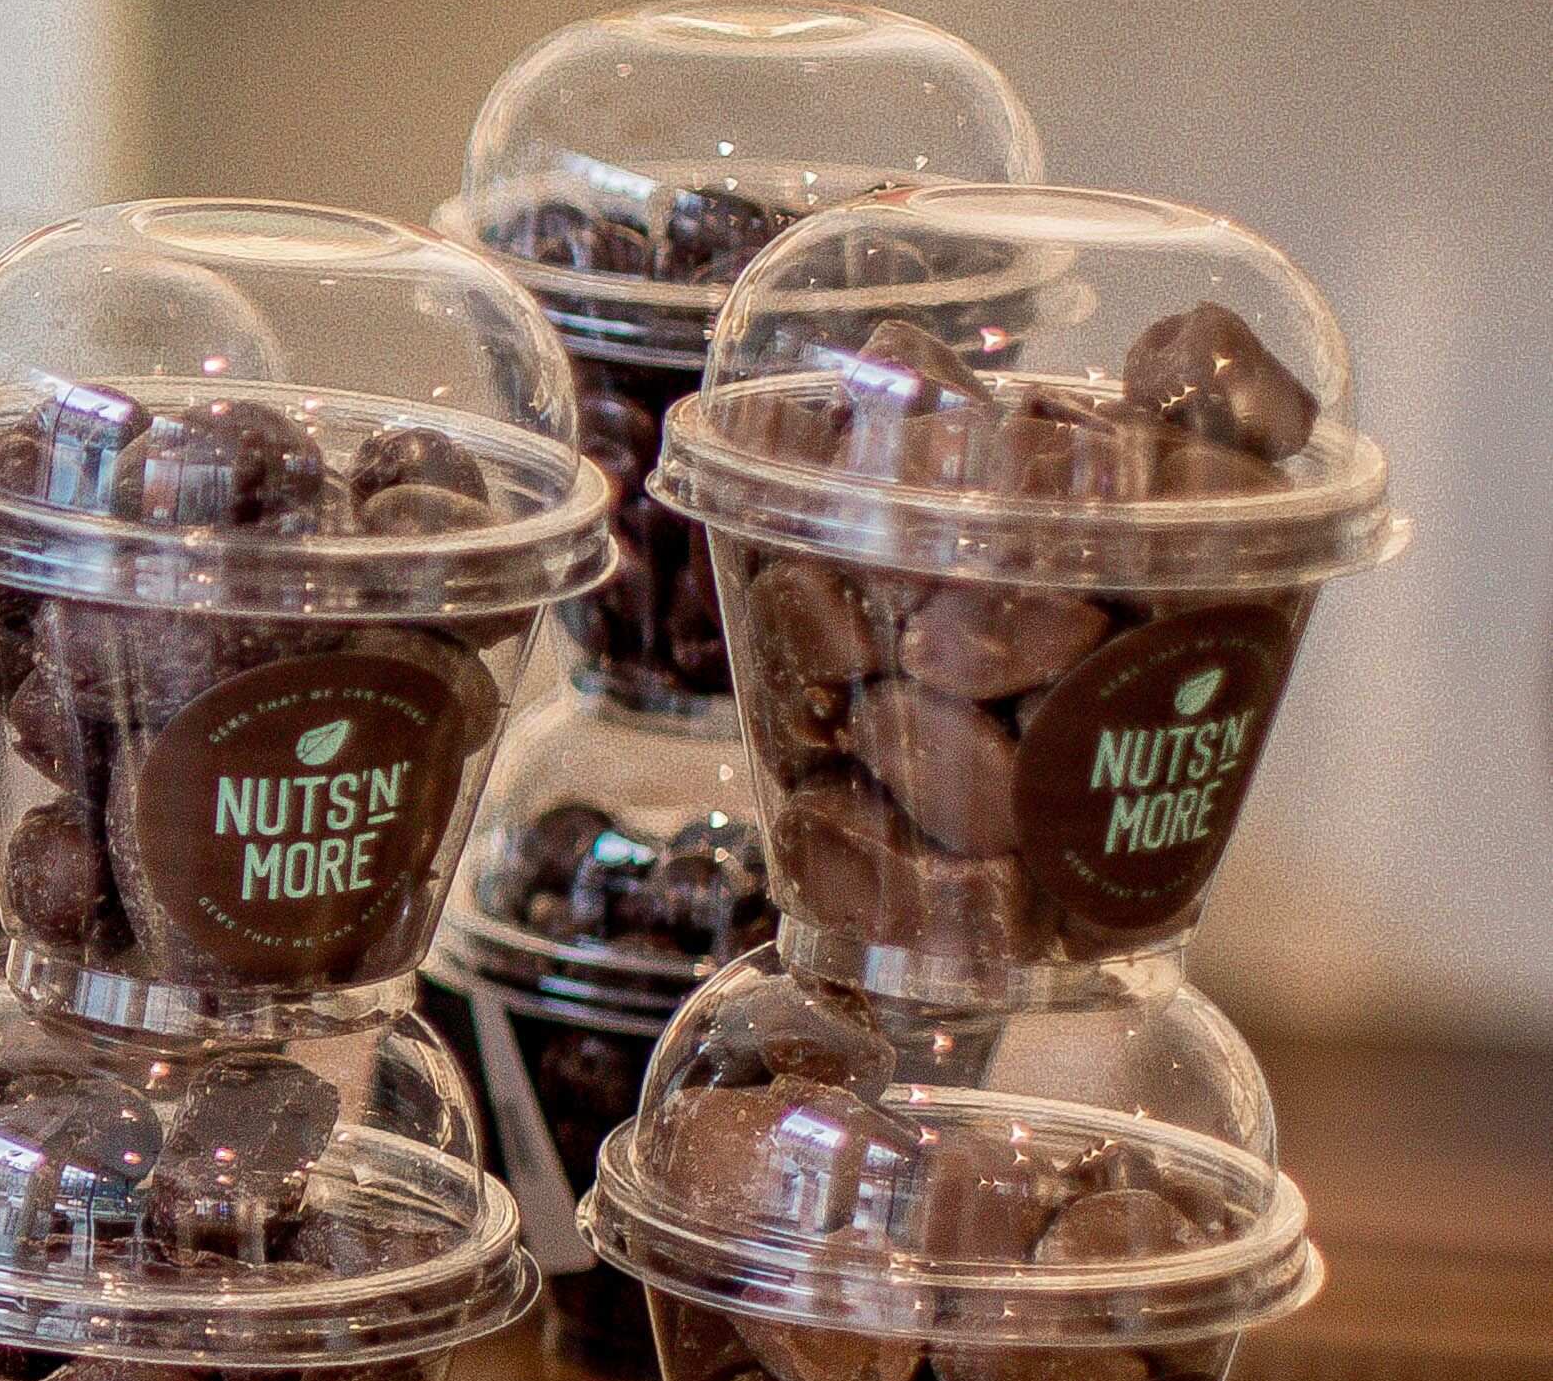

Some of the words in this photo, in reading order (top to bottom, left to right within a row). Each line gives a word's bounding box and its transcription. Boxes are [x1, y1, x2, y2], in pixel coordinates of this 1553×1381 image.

[215, 760, 412, 836] NUTS'N'
[1104, 781, 1223, 855] MORE
[242, 831, 381, 901] MORE
